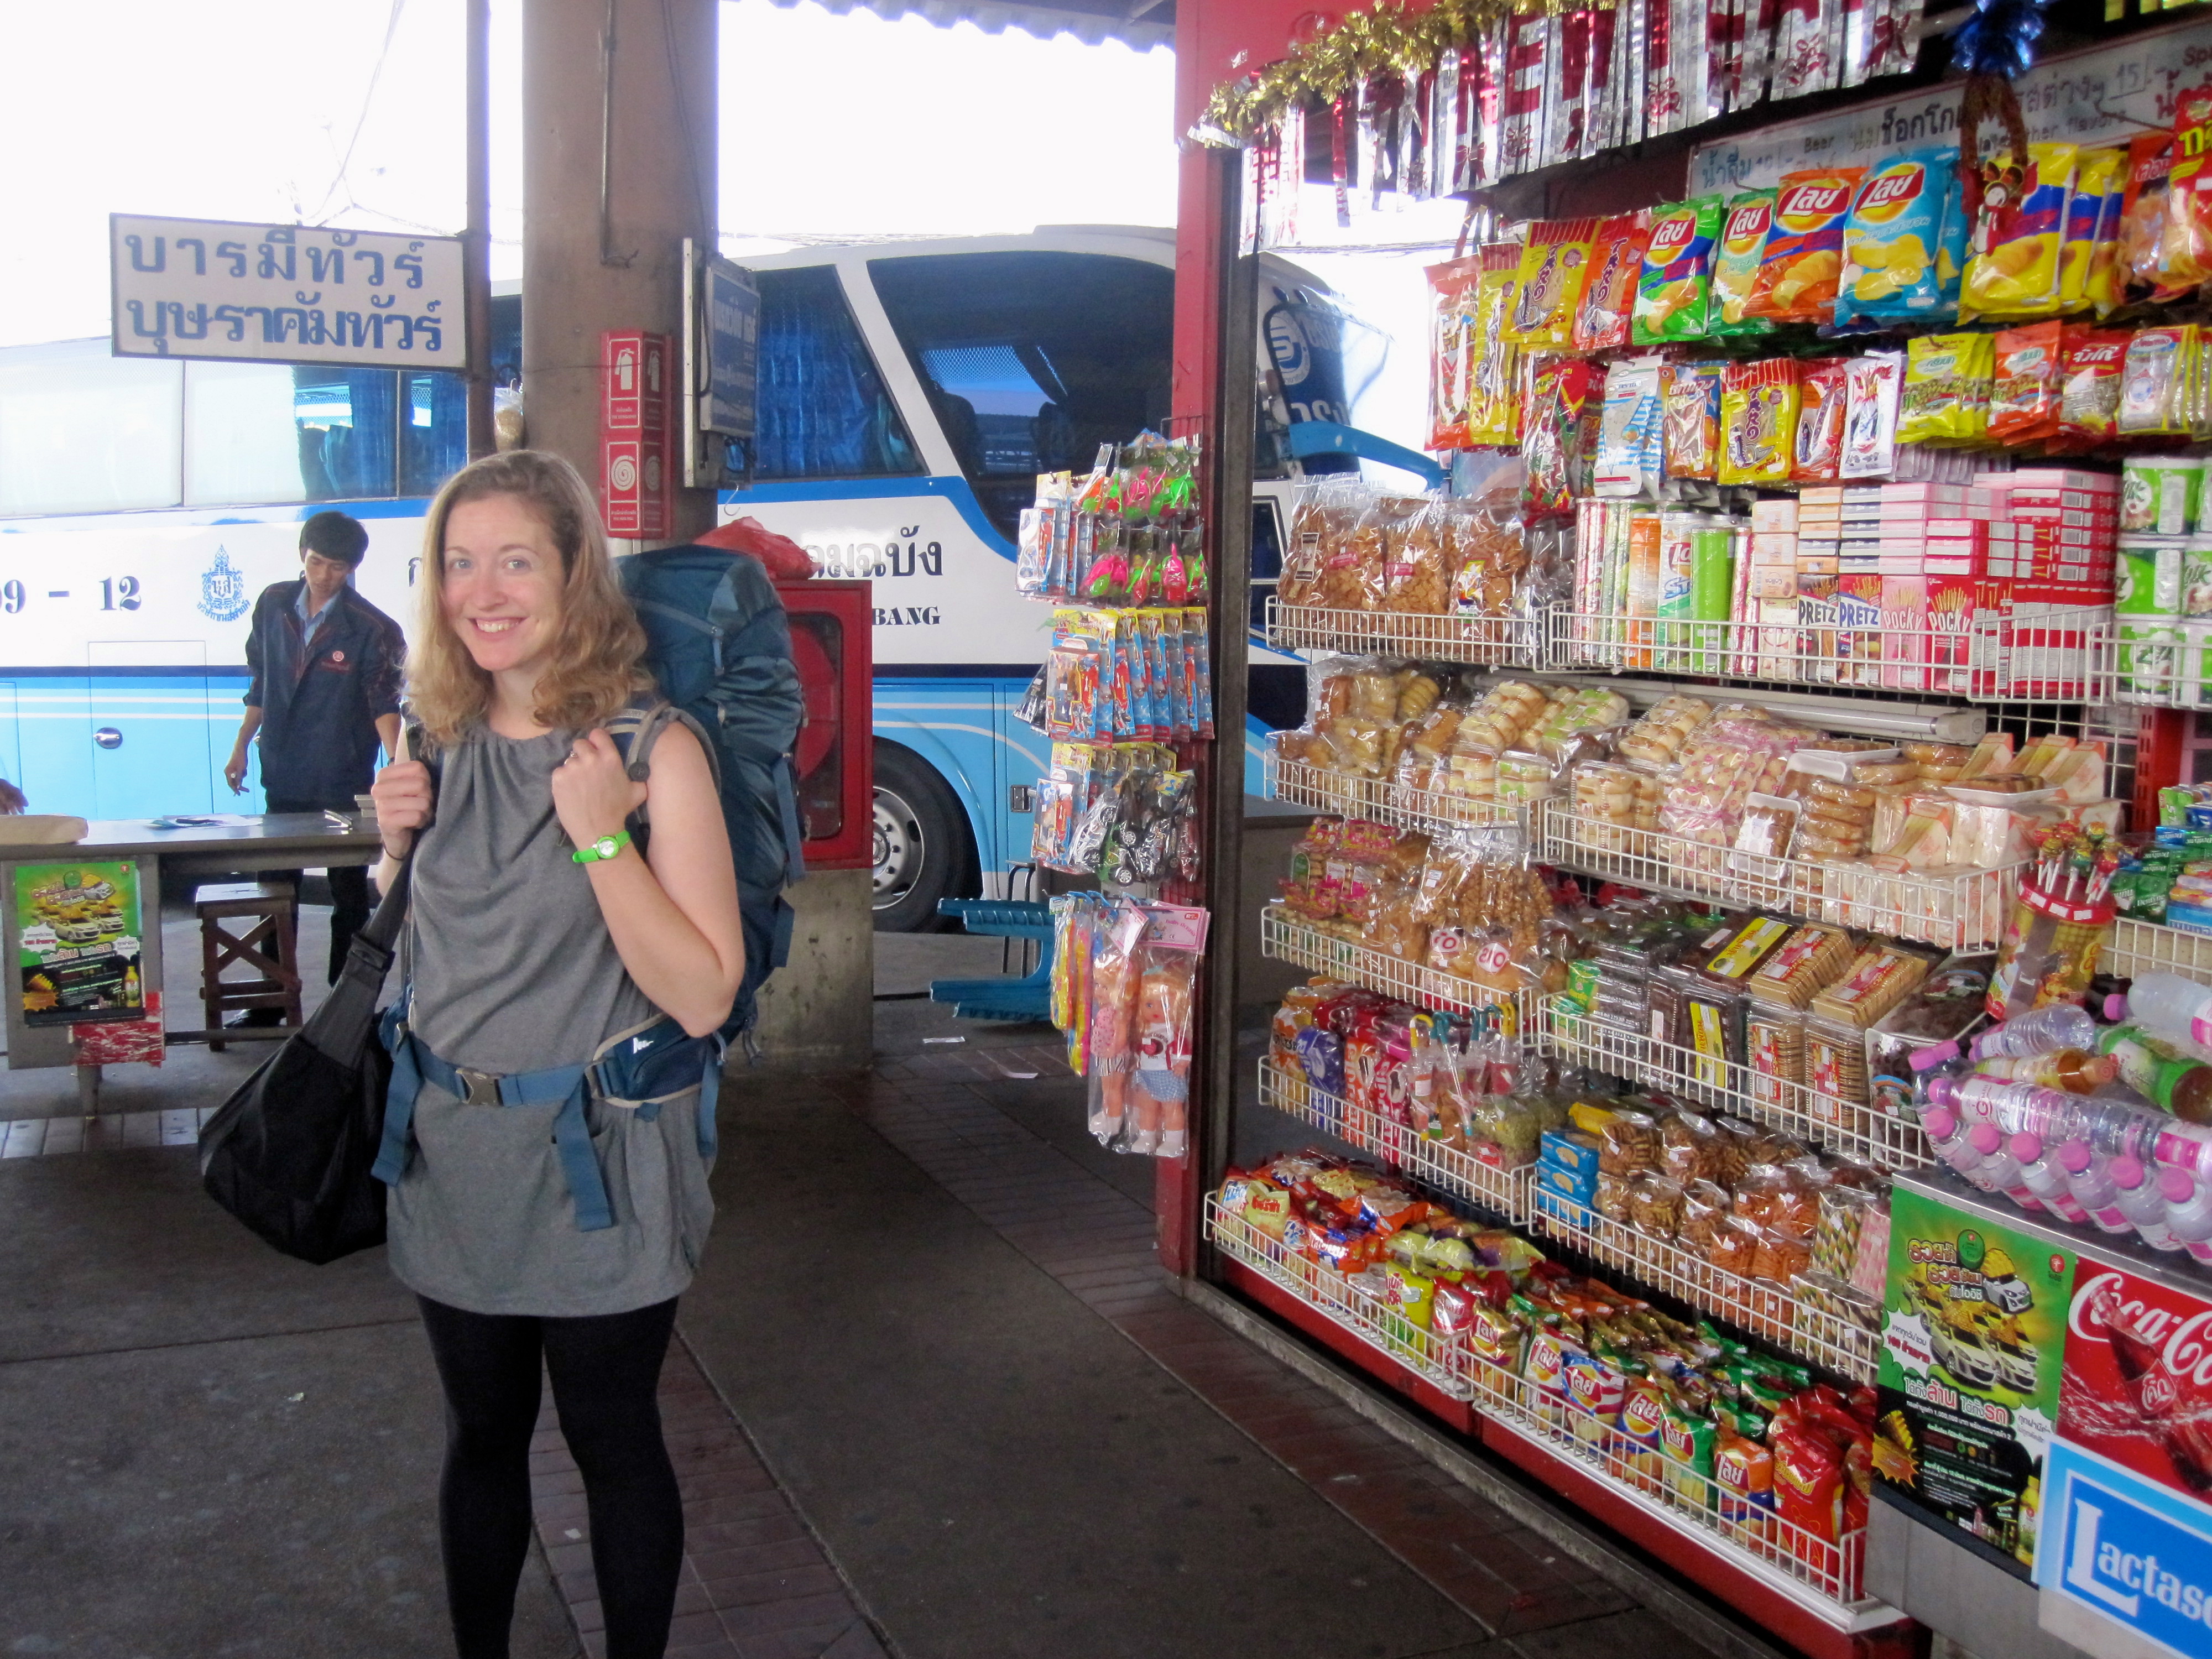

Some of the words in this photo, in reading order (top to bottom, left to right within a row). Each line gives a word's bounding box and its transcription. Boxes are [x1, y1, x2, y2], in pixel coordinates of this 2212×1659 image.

[125, 229, 425, 289] บารมีทัวร์
[126, 290, 443, 355] บุษราคัมทัวร์
[0, 579, 27, 614] 9
[99, 575, 143, 612] 12
[872, 606, 941, 625] BANG
[1798, 599, 1836, 625] PRETZ
[1839, 601, 1879, 627] PRETZ
[1882, 607, 1923, 630] POCKY
[1927, 608, 1971, 632] POCKY
